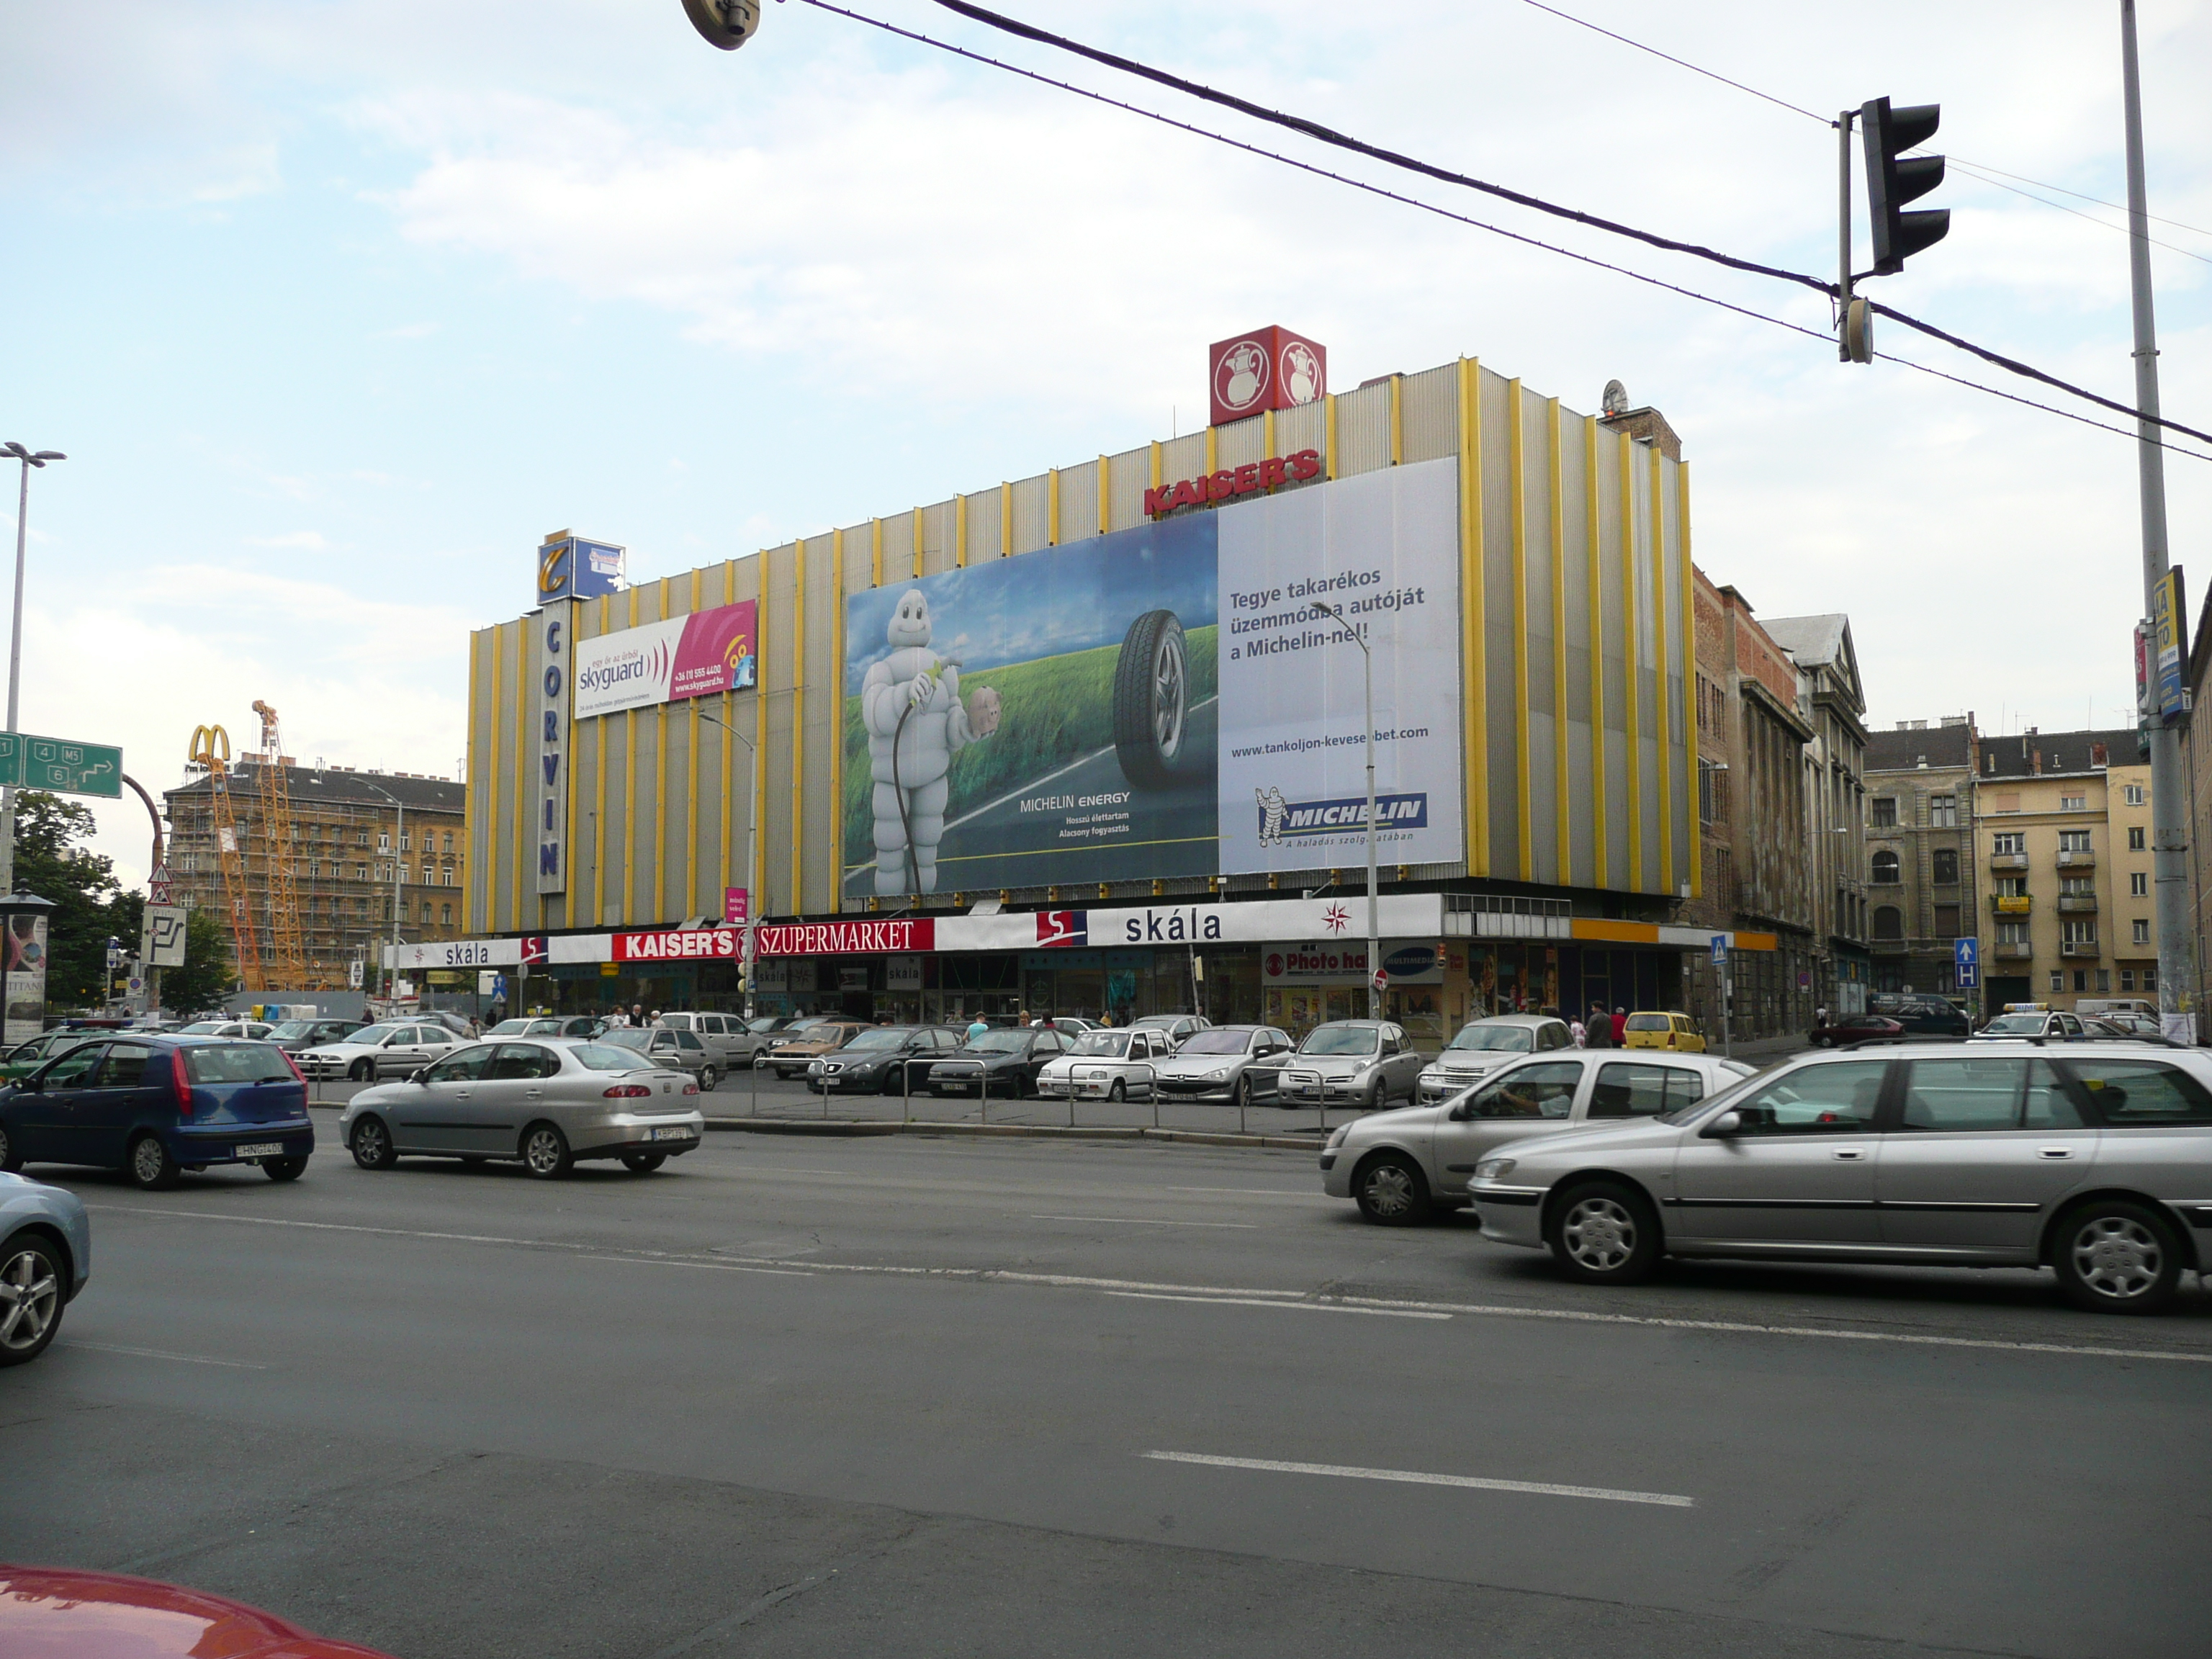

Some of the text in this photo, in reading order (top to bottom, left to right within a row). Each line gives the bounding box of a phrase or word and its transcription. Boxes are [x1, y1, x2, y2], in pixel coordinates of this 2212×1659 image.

[1144, 449, 1320, 516] KAISER'S
[1231, 570, 1380, 609] Tegye takarékos
[1231, 587, 1425, 634] üzemmódba autóját
[613, 652, 620, 662] az
[1231, 647, 1241, 660] a
[580, 655, 643, 692] skyguard
[675, 672, 685, 681] +36
[694, 667, 706, 678] 555
[706, 664, 721, 675] 4400
[675, 675, 724, 693] www.skyguard.hu
[40, 747, 79, 761] 4 M5
[540, 621, 561, 876] CORVIN
[54, 770, 63, 781] 6
[1020, 791, 1130, 812] MICHELIN ENERGY
[1092, 811, 1129, 822] élettartam
[1290, 800, 1421, 827] MICHELIN
[1059, 824, 1130, 838] Alacsony fogyasztás
[1286, 832, 1413, 849] A haladás szolgatában
[1126, 908, 1221, 942] skála
[626, 931, 734, 958] KAISER'S
[760, 921, 914, 954] SZUPERMARKET
[446, 942, 488, 965] skála
[1287, 953, 1339, 969] Photo
[1959, 966, 1974, 985] H
